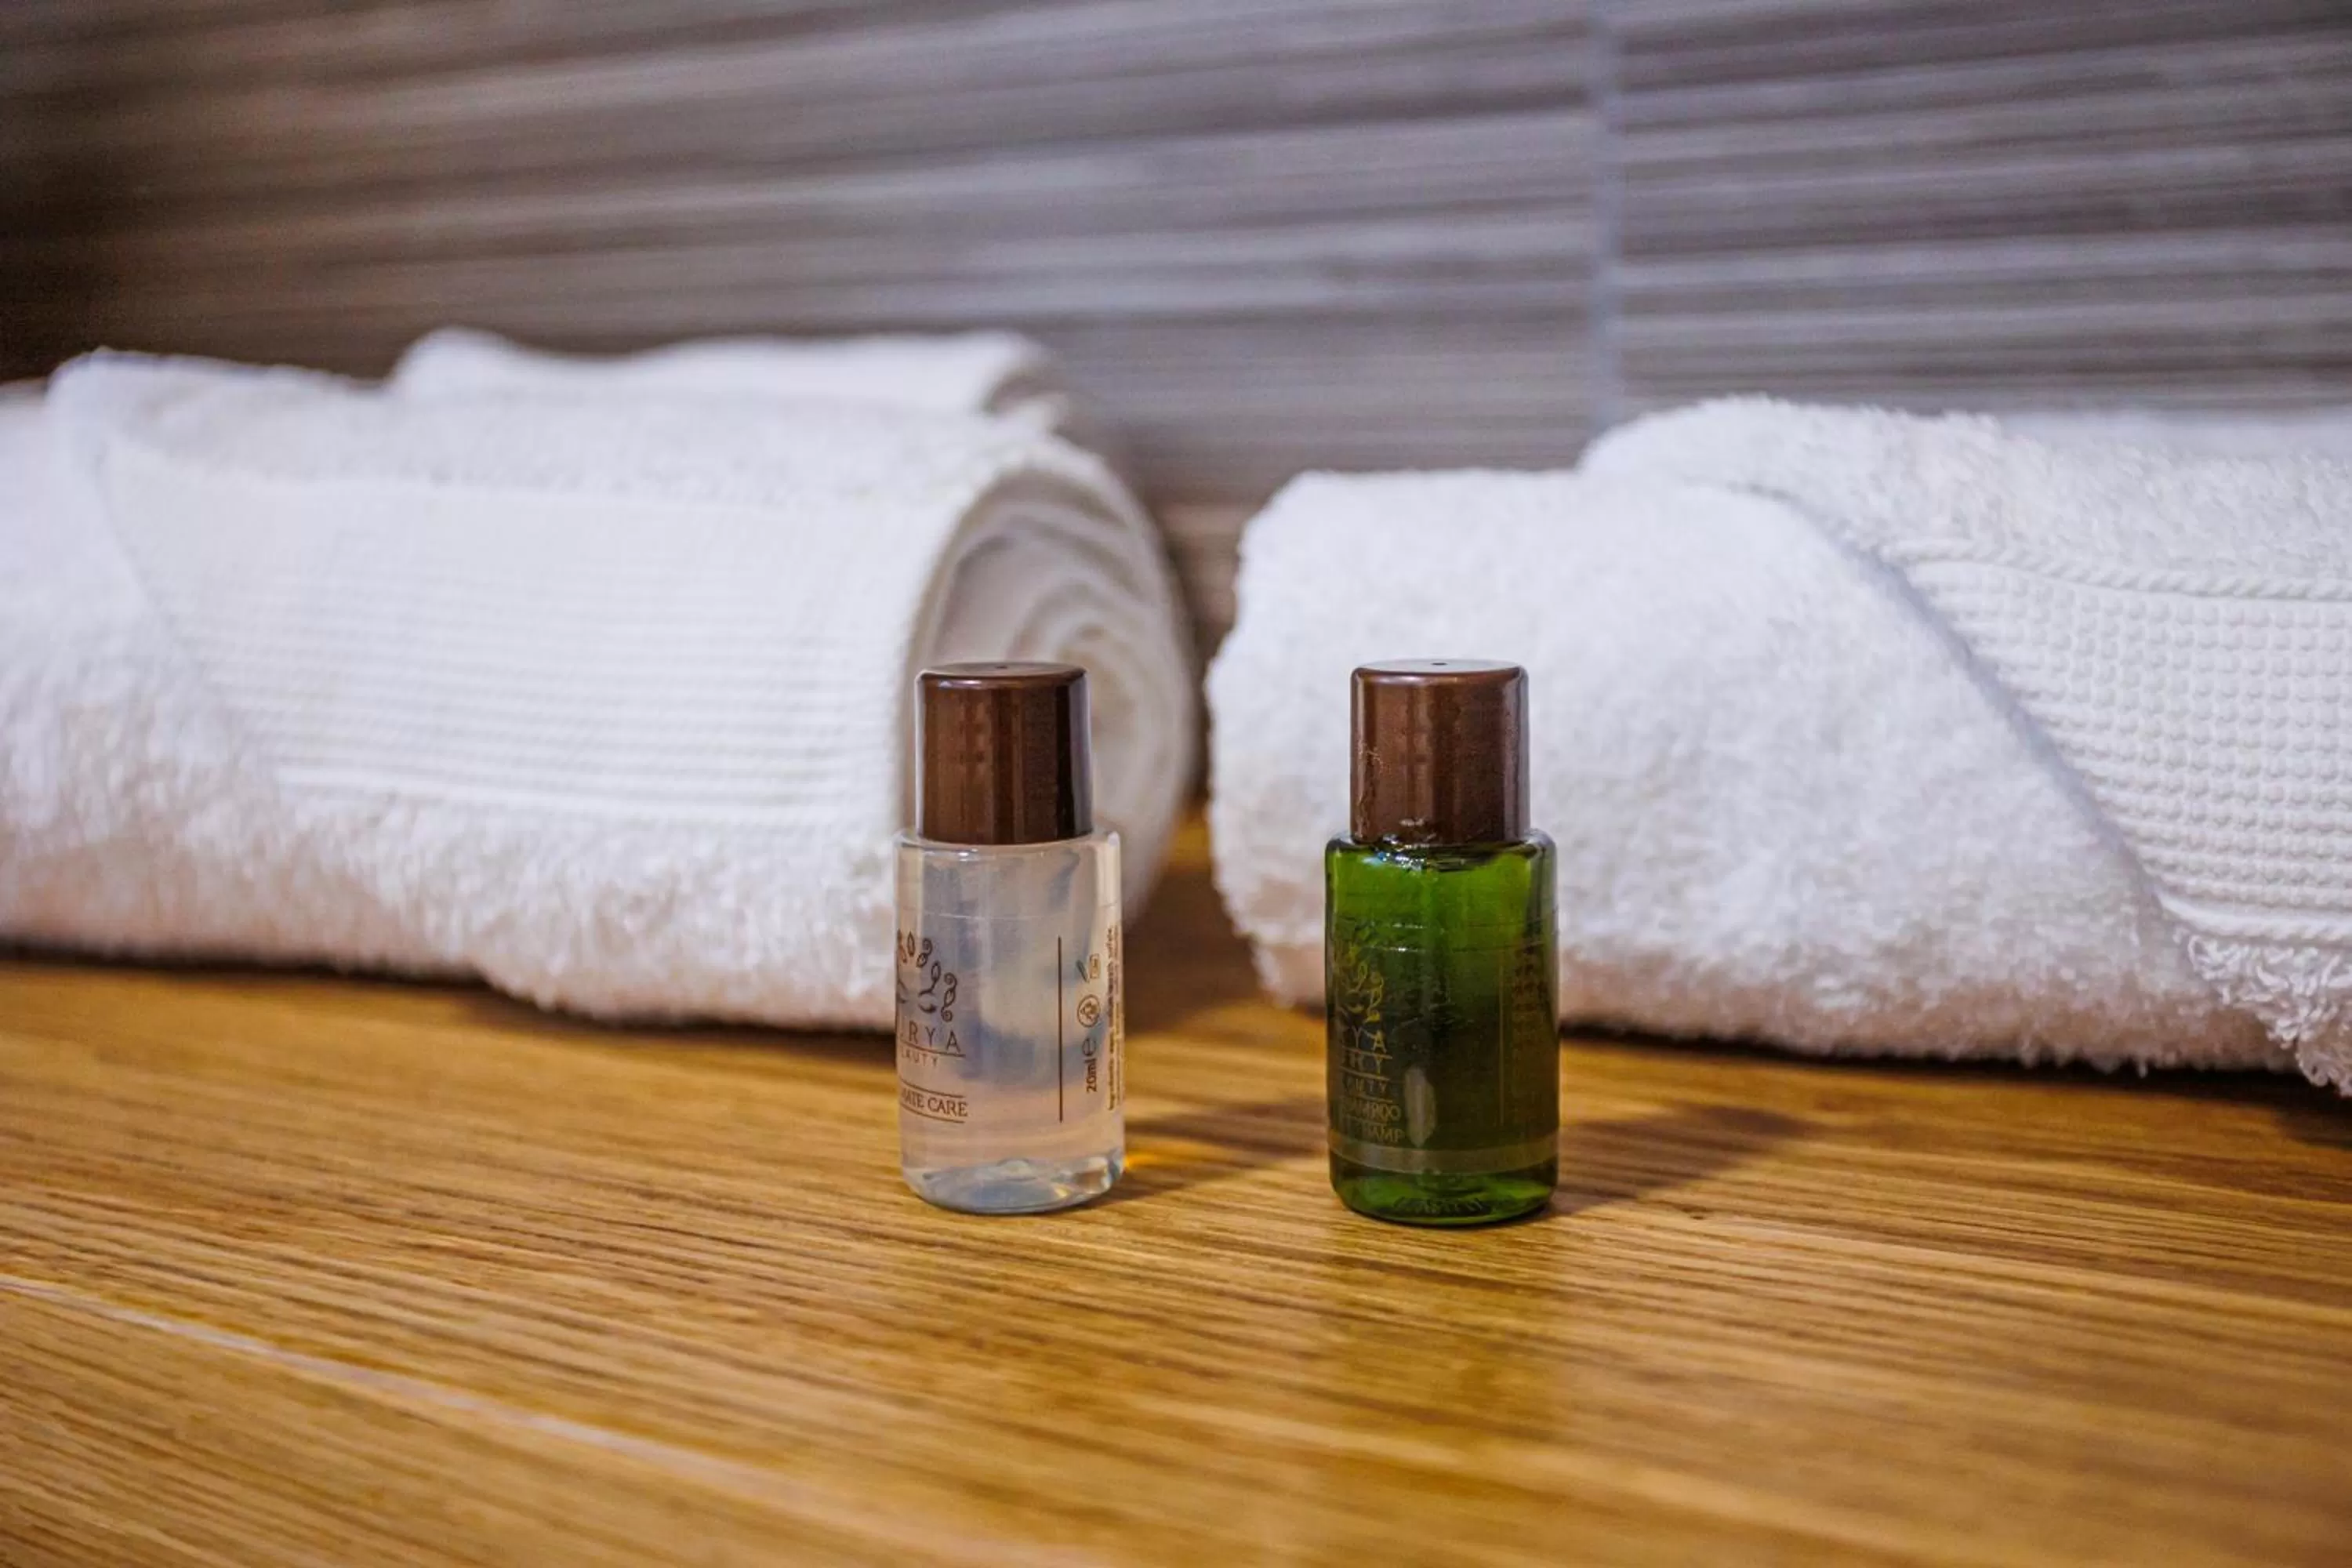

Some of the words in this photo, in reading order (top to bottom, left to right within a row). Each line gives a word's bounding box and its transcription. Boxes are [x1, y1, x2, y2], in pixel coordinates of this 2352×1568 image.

[900, 1019, 961, 1053] RYA
[1084, 1058, 1097, 1094] 20ml
[927, 1097, 968, 1118] CARE
